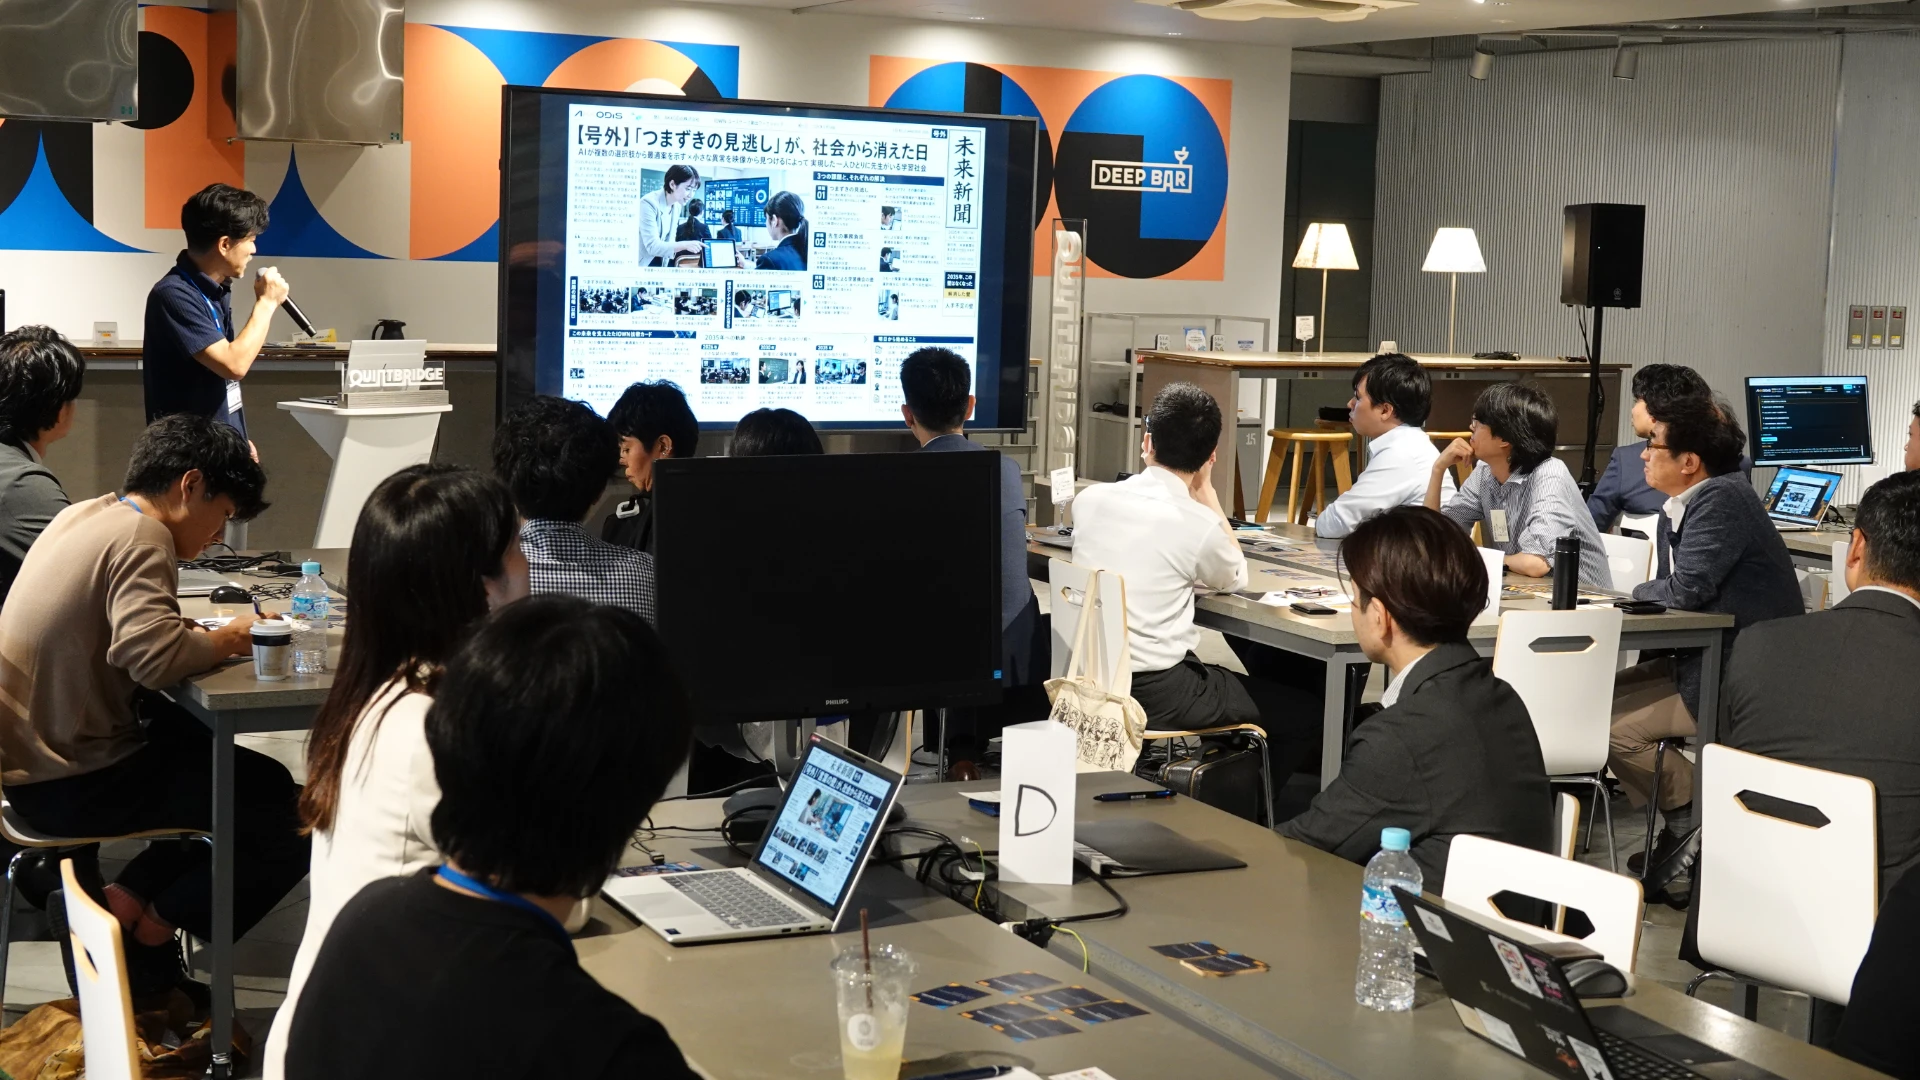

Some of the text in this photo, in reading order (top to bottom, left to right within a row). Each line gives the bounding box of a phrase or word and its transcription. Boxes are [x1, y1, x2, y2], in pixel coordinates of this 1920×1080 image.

[953, 135, 976, 224] 未来新聞
[1099, 167, 1186, 192] DEEP BAR
[817, 191, 826, 199] 01
[815, 238, 824, 246] 02
[813, 280, 823, 289] 03
[350, 367, 443, 387] QUINTBRIDGE
[1245, 432, 1256, 446] 15
[1014, 783, 1057, 837] D
